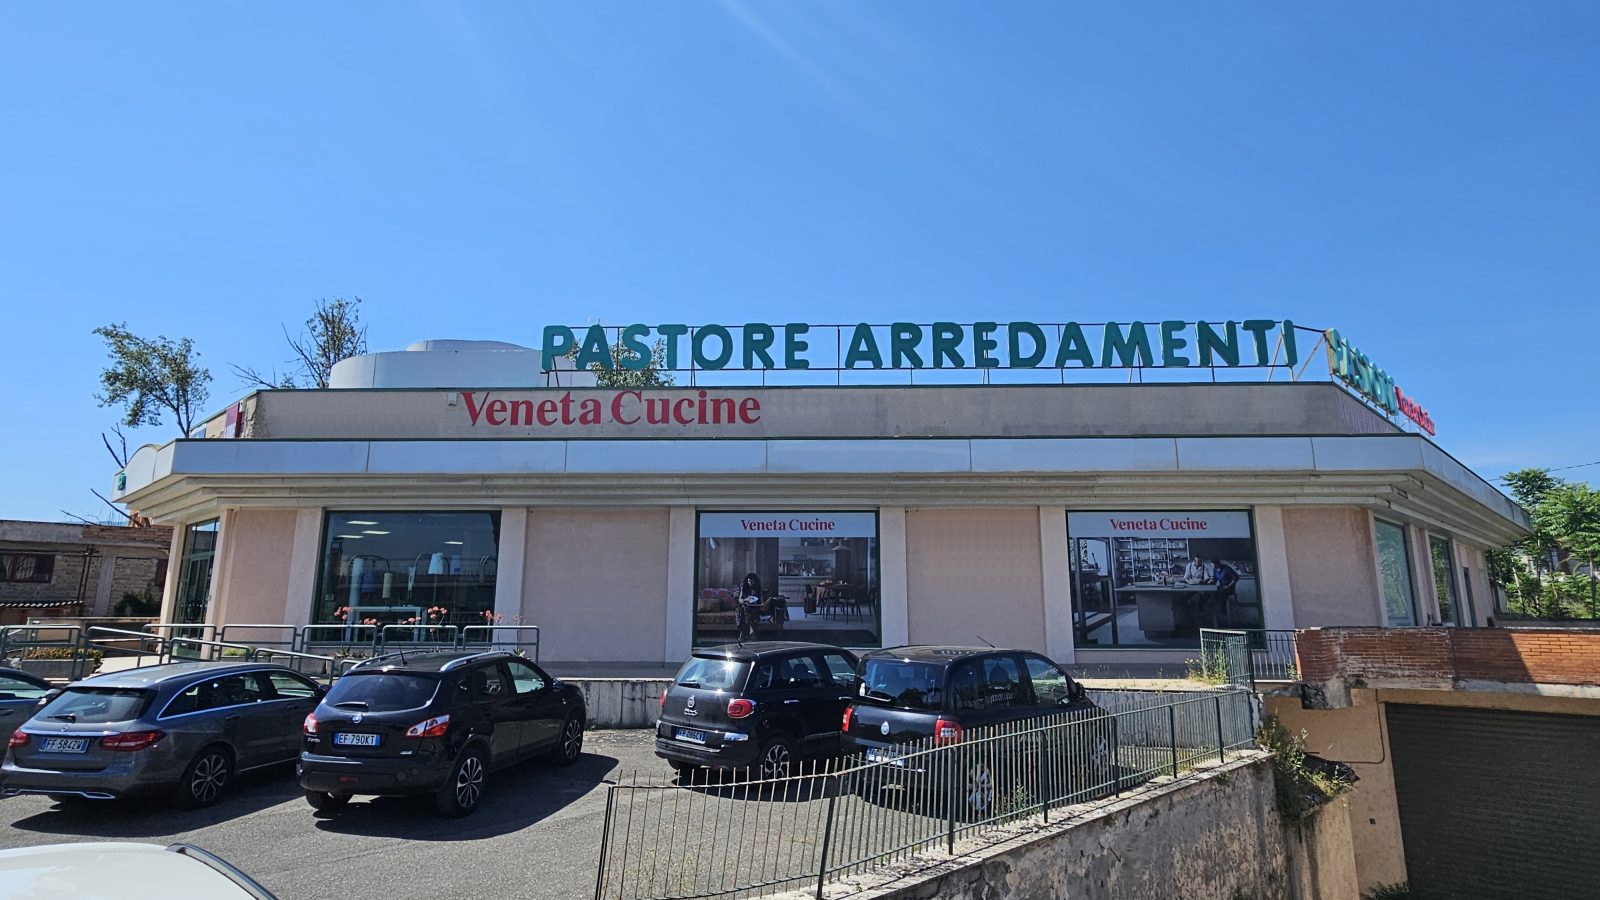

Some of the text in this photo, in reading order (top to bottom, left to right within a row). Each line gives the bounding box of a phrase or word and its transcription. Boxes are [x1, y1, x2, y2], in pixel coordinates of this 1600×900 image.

[541, 319, 1298, 370] PASTORE ARREDAMENTI
[460, 390, 761, 426] Veneta Cucine
[741, 518, 835, 531] Veneta Cucine
[1109, 517, 1207, 531] Veneta Cucine
[47, 739, 57, 748] FF
[338, 734, 375, 745] EF 790KT
